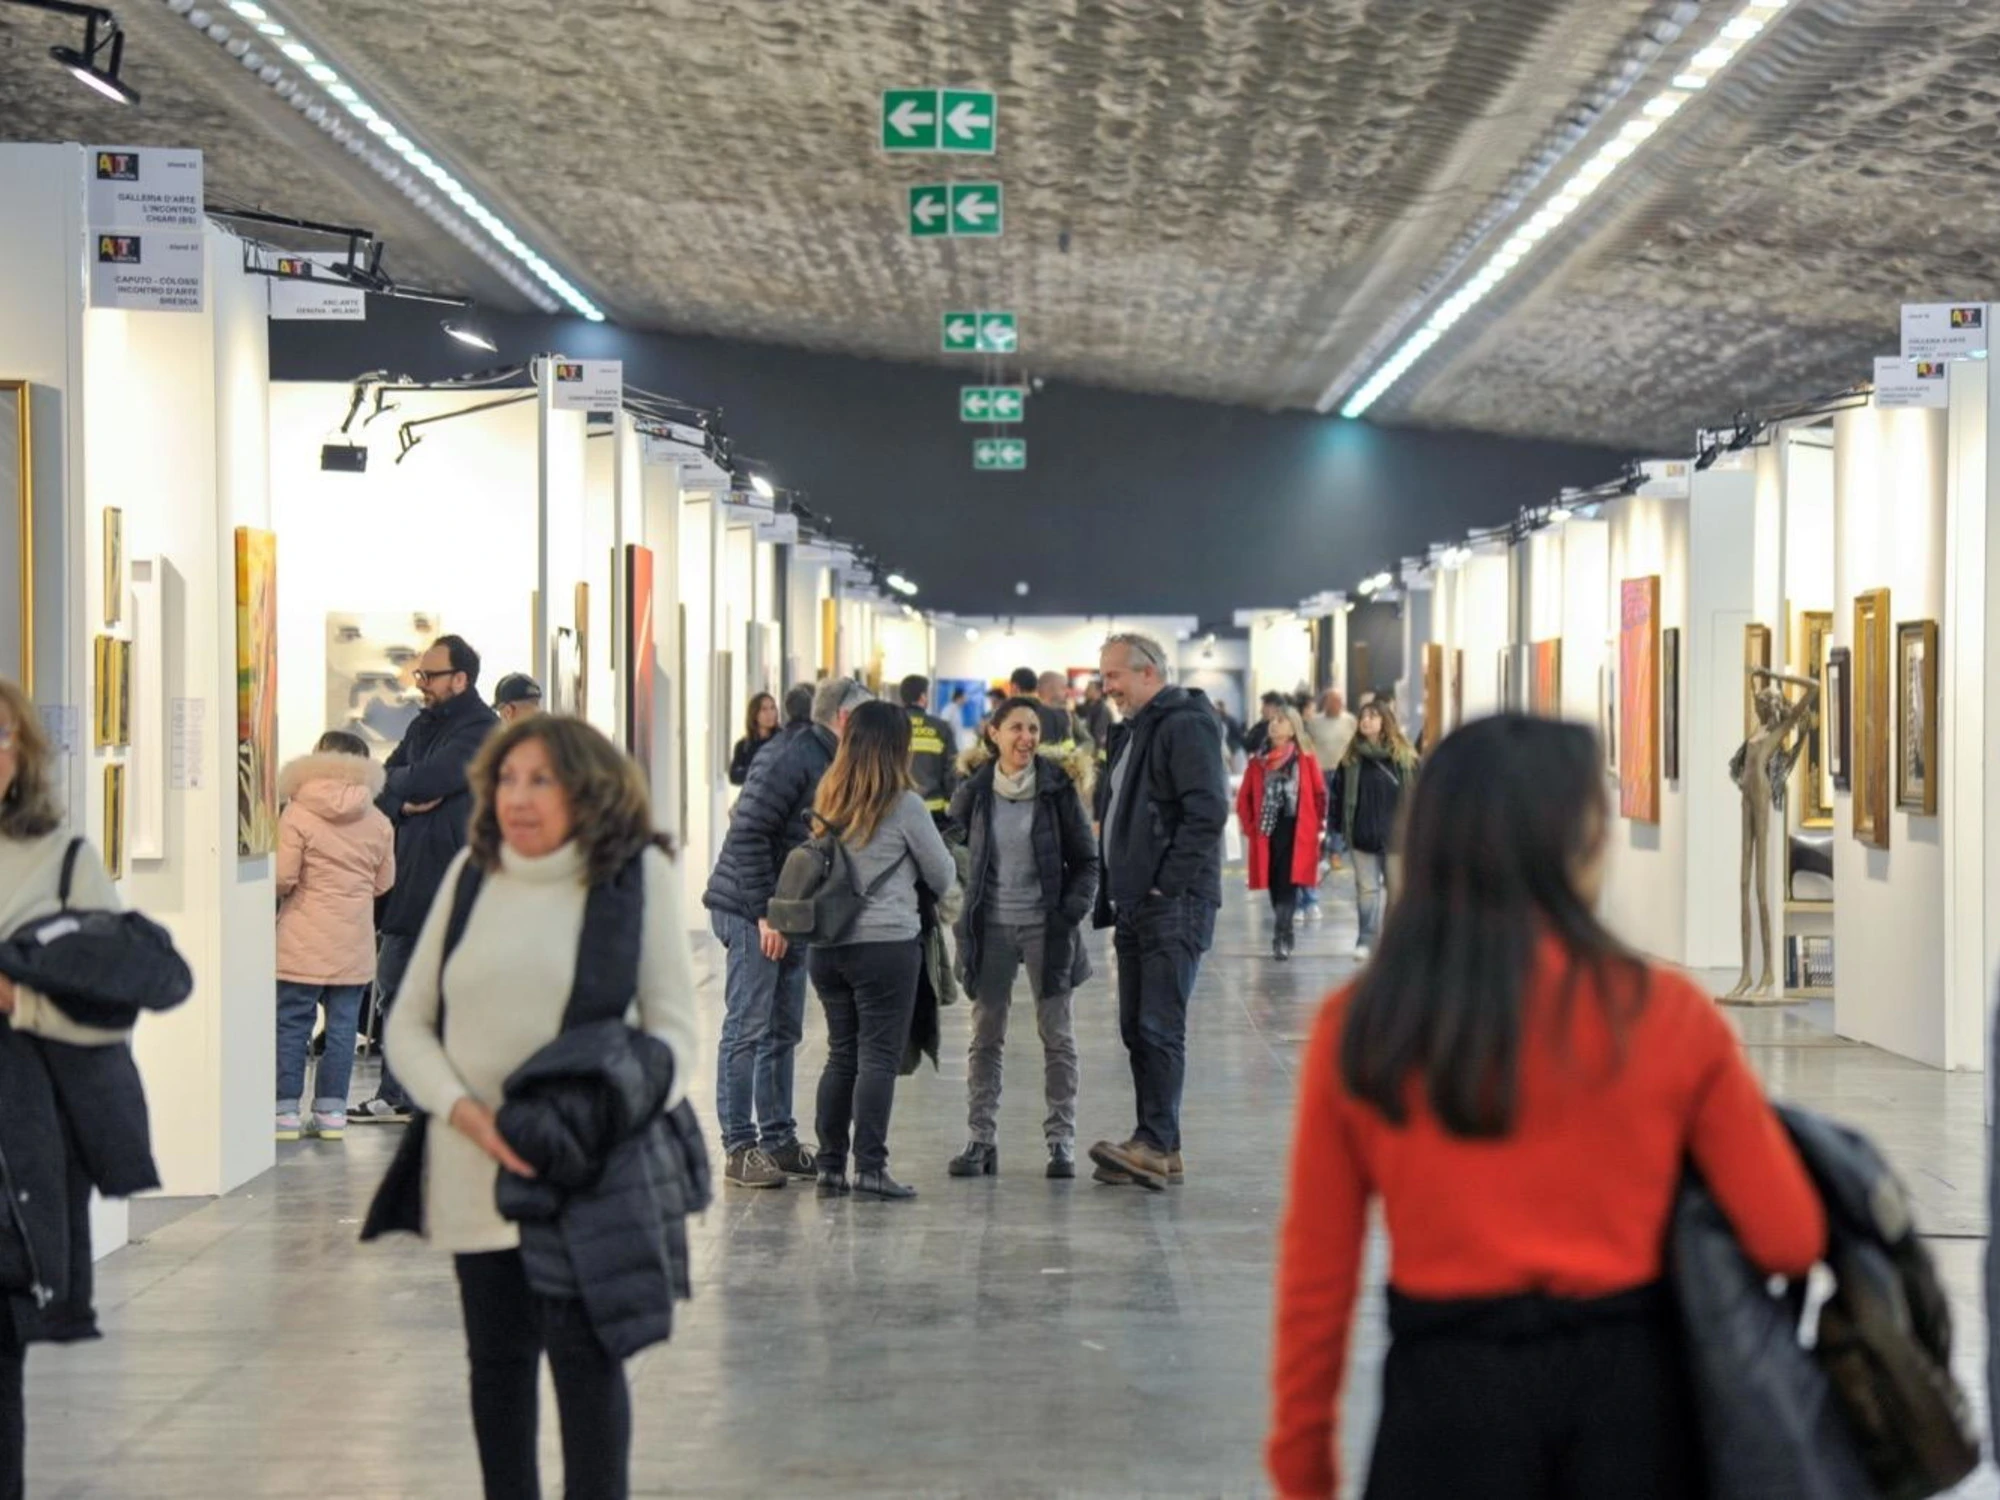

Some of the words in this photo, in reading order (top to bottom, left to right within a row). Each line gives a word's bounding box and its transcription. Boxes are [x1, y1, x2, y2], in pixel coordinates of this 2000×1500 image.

[118, 193, 162, 202] GALLERIA
[164, 194, 196, 204] D'ARTE
[142, 204, 197, 214] L'INCONTRO
[146, 214, 177, 223] CHIARI
[115, 275, 152, 284] CAPUTO
[159, 276, 198, 286] COLOSSI
[118, 285, 164, 295] INCONTRO
[166, 287, 198, 297] D'ARTE
[160, 297, 198, 306] BRESCIA
